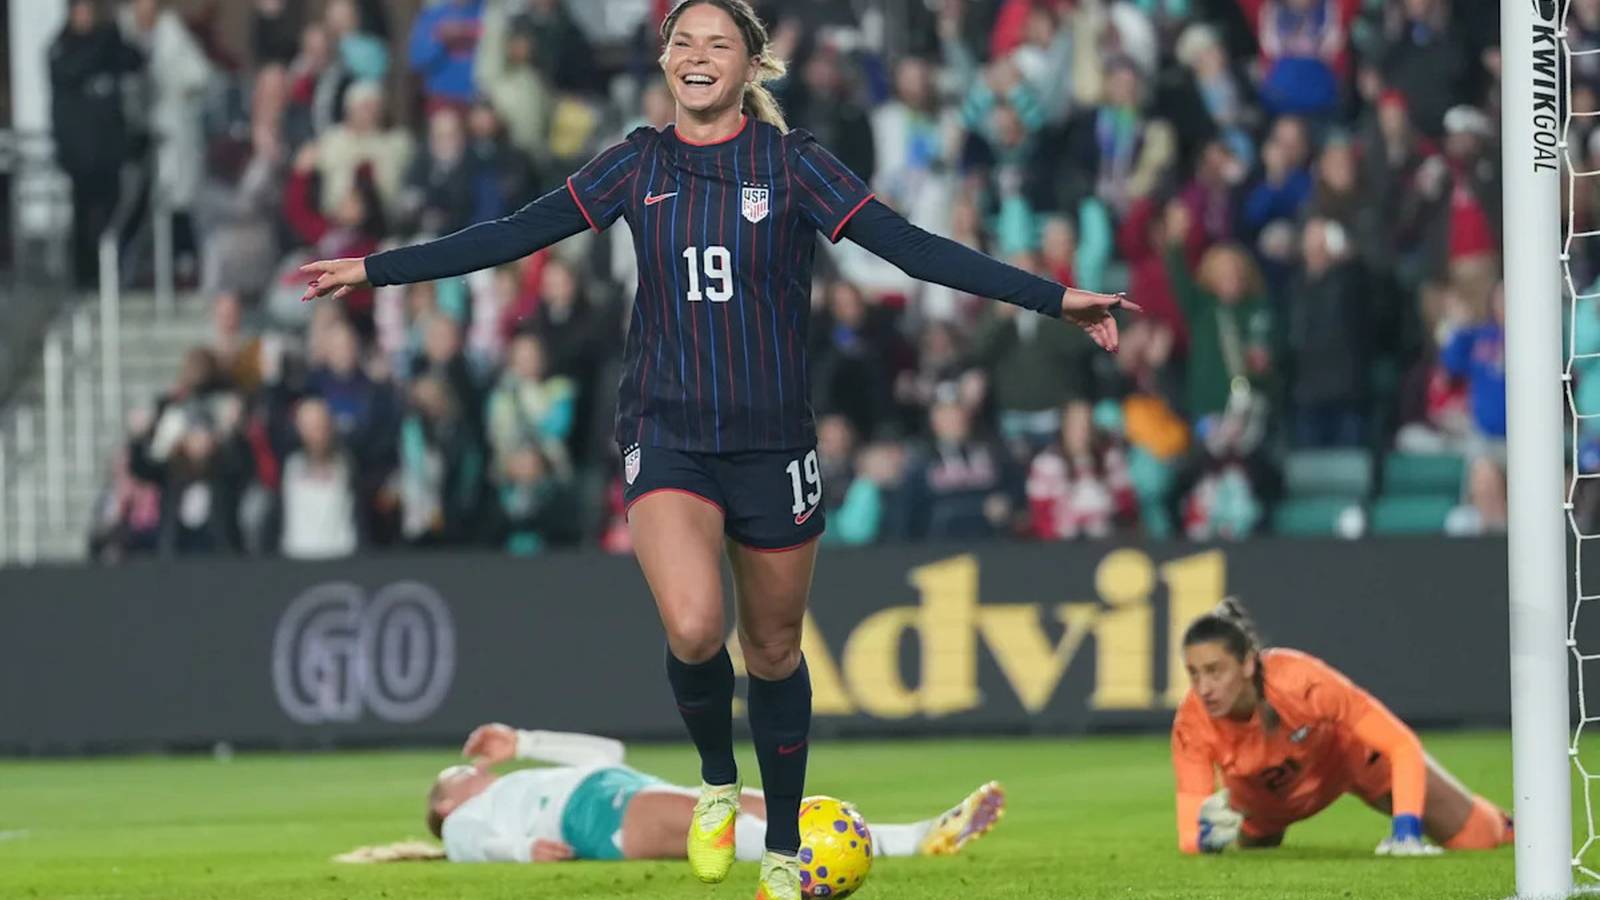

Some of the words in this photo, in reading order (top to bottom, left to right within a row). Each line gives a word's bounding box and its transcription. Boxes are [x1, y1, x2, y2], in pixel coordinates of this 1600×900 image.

[743, 189, 767, 204] USA
[682, 246, 734, 302] 19
[786, 449, 822, 514] 19
[273, 581, 456, 724] GO
